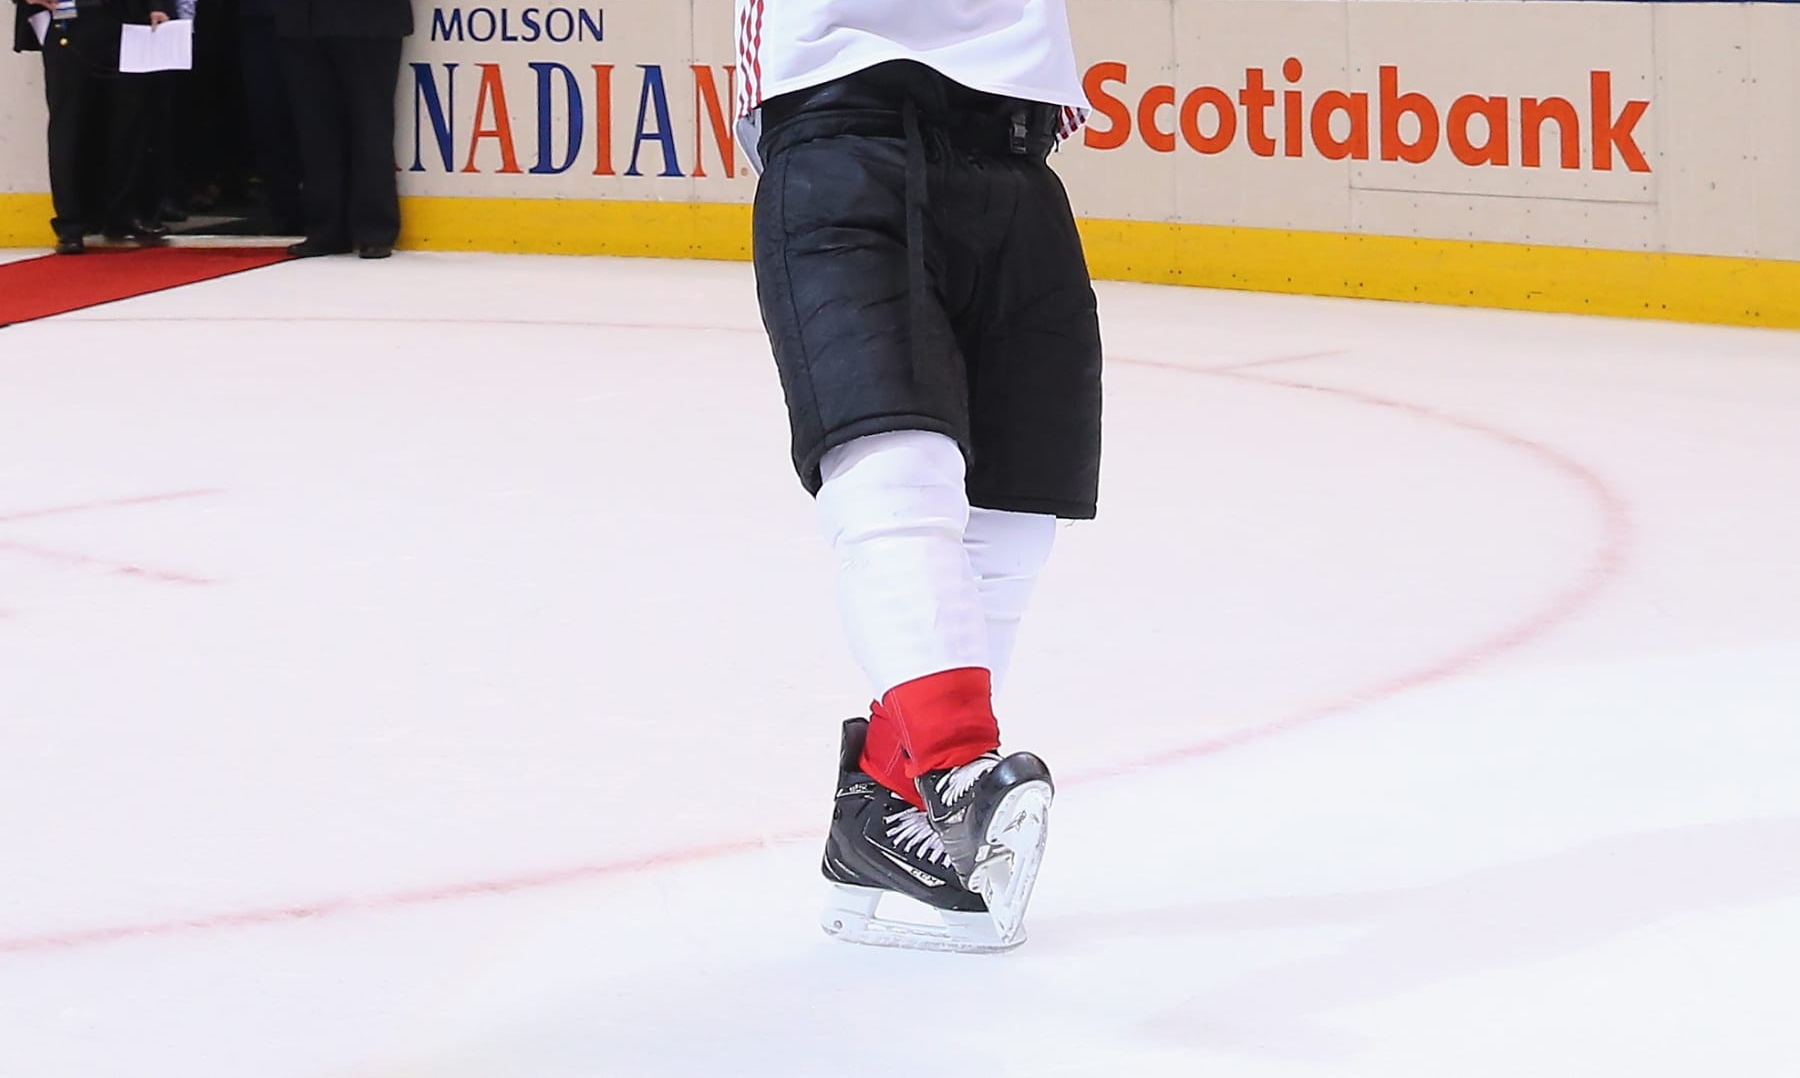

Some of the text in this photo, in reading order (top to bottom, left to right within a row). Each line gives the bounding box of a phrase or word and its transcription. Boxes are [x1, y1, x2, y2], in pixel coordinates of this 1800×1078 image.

[431, 8, 604, 42] MOLSON
[396, 62, 736, 179] NADIAN
[1082, 57, 1652, 173] Scotiabank
